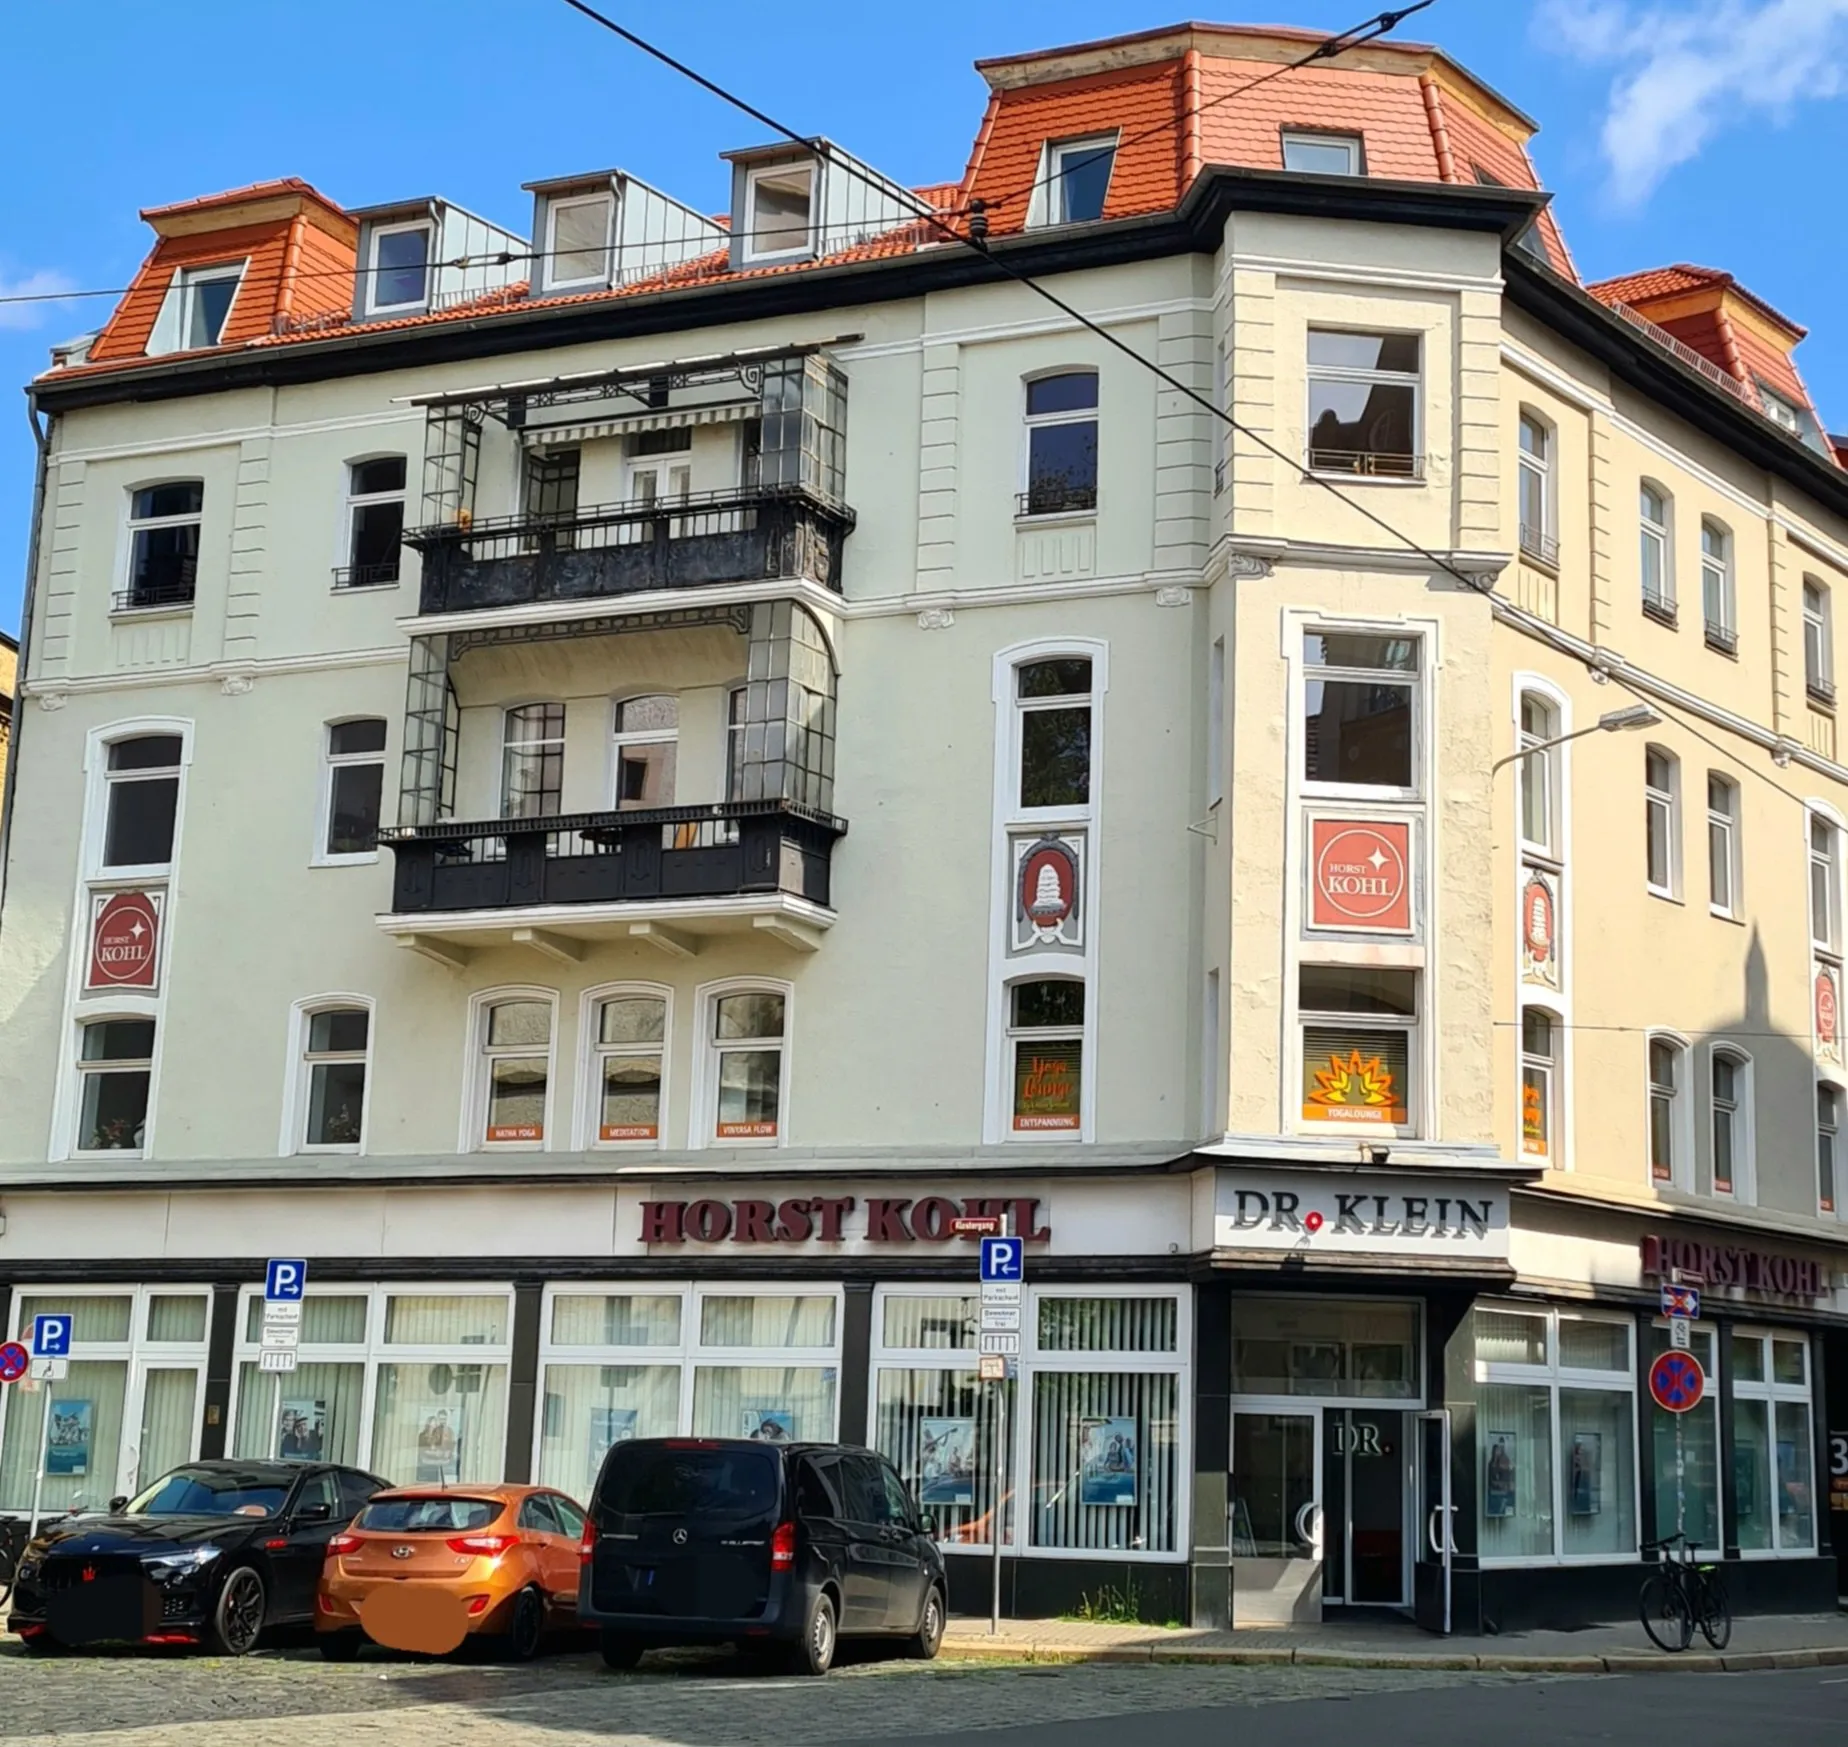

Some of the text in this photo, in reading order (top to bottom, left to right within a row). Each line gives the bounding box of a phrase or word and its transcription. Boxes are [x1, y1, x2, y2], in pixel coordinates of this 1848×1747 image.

[1329, 863, 1367, 874] HORST
[1327, 875, 1394, 896] KOHL
[101, 945, 146, 962] KOHL
[1020, 1117, 1076, 1128] ENTSPANNUNG
[1327, 1107, 1383, 1120] YOGALOUNGE
[609, 1127, 651, 1137] MEDITATION
[638, 1196, 1052, 1243] HORST KOHL
[1331, 1194, 1494, 1240] KLEIN
[1641, 1235, 1829, 1299] HORST KOHL
[1829, 1437, 1848, 1475] 3
